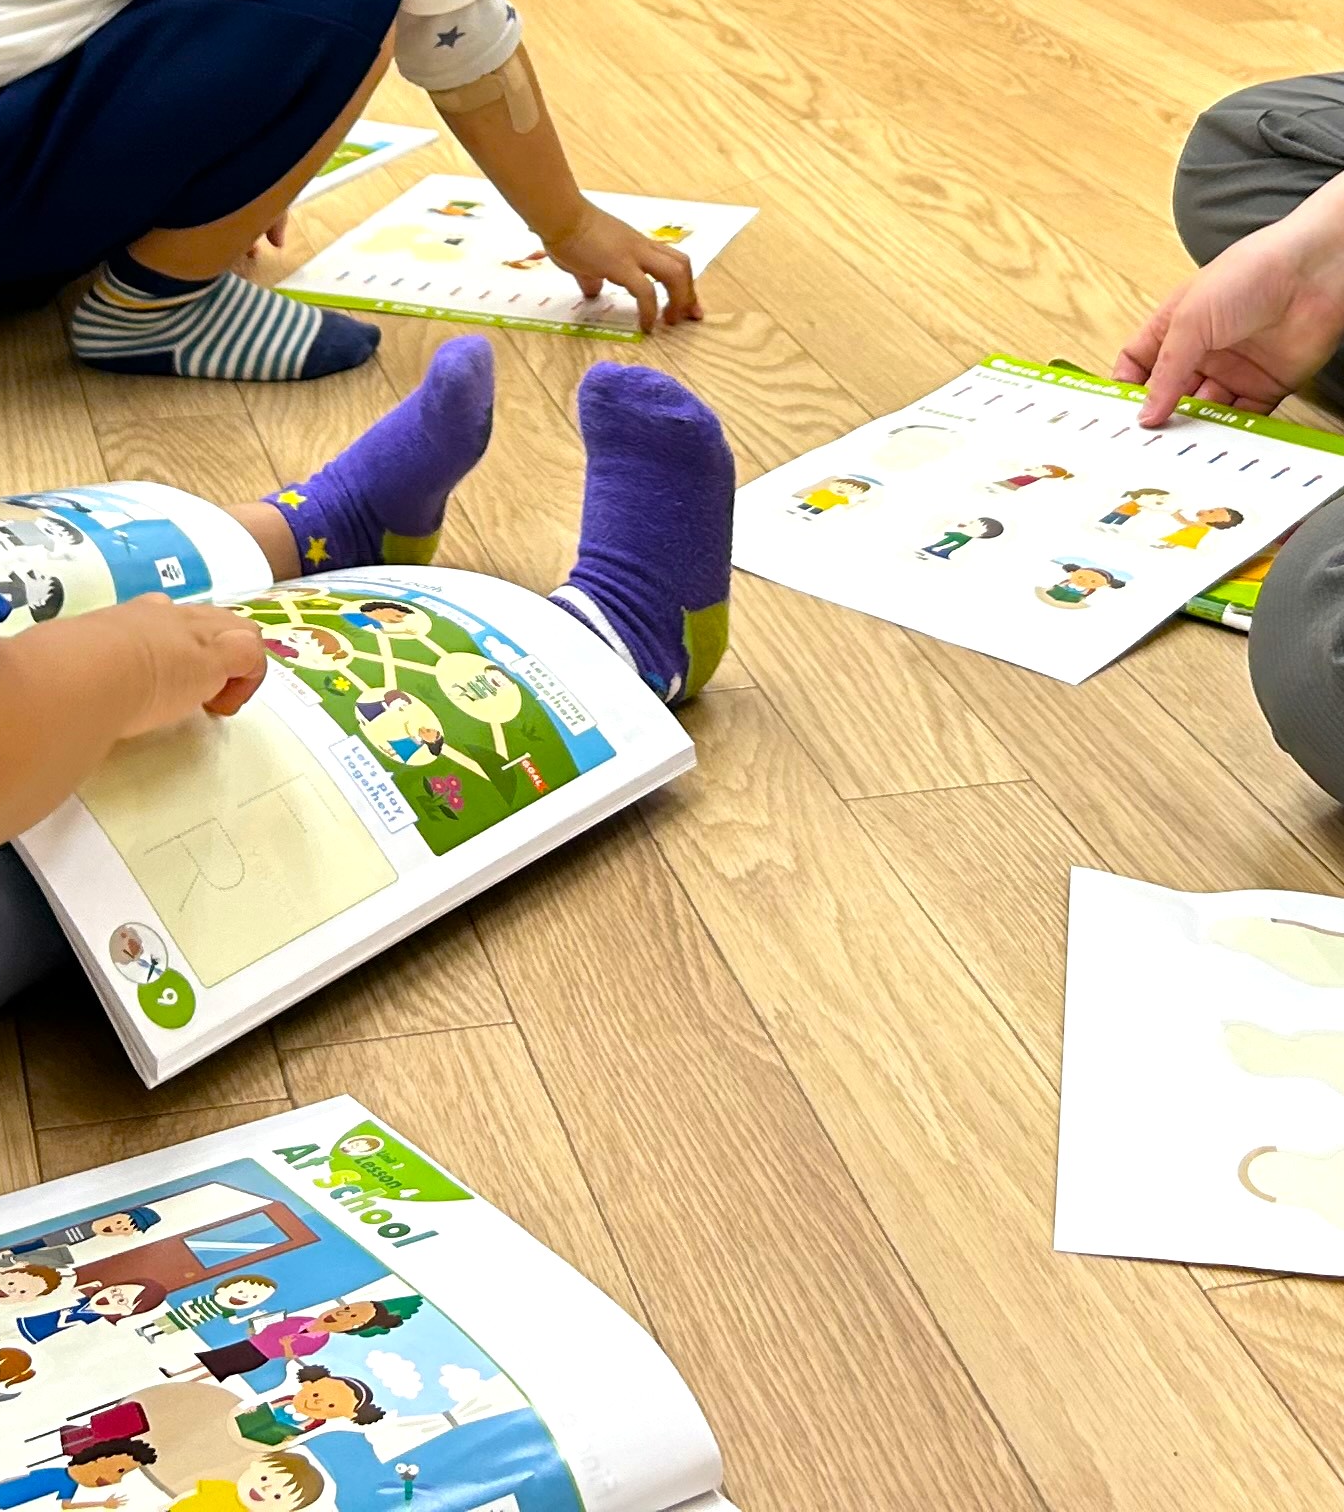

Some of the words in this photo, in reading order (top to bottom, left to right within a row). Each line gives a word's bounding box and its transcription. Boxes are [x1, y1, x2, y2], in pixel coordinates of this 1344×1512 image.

[1198, 407, 1238, 424] Unit
[1244, 418, 1255, 428] 1
[528, 661, 556, 688] Let's
[555, 688, 586, 724] jump
[351, 745, 378, 778] Let's
[376, 782, 405, 816] play
[521, 758, 544, 787] GOAL
[343, 754, 398, 824] together!
[157, 987, 179, 1006] 9
[271, 1142, 335, 1171] At
[353, 1155, 403, 1190] Lesson
[375, 1148, 398, 1165] Unit
[311, 1168, 440, 1249] School
